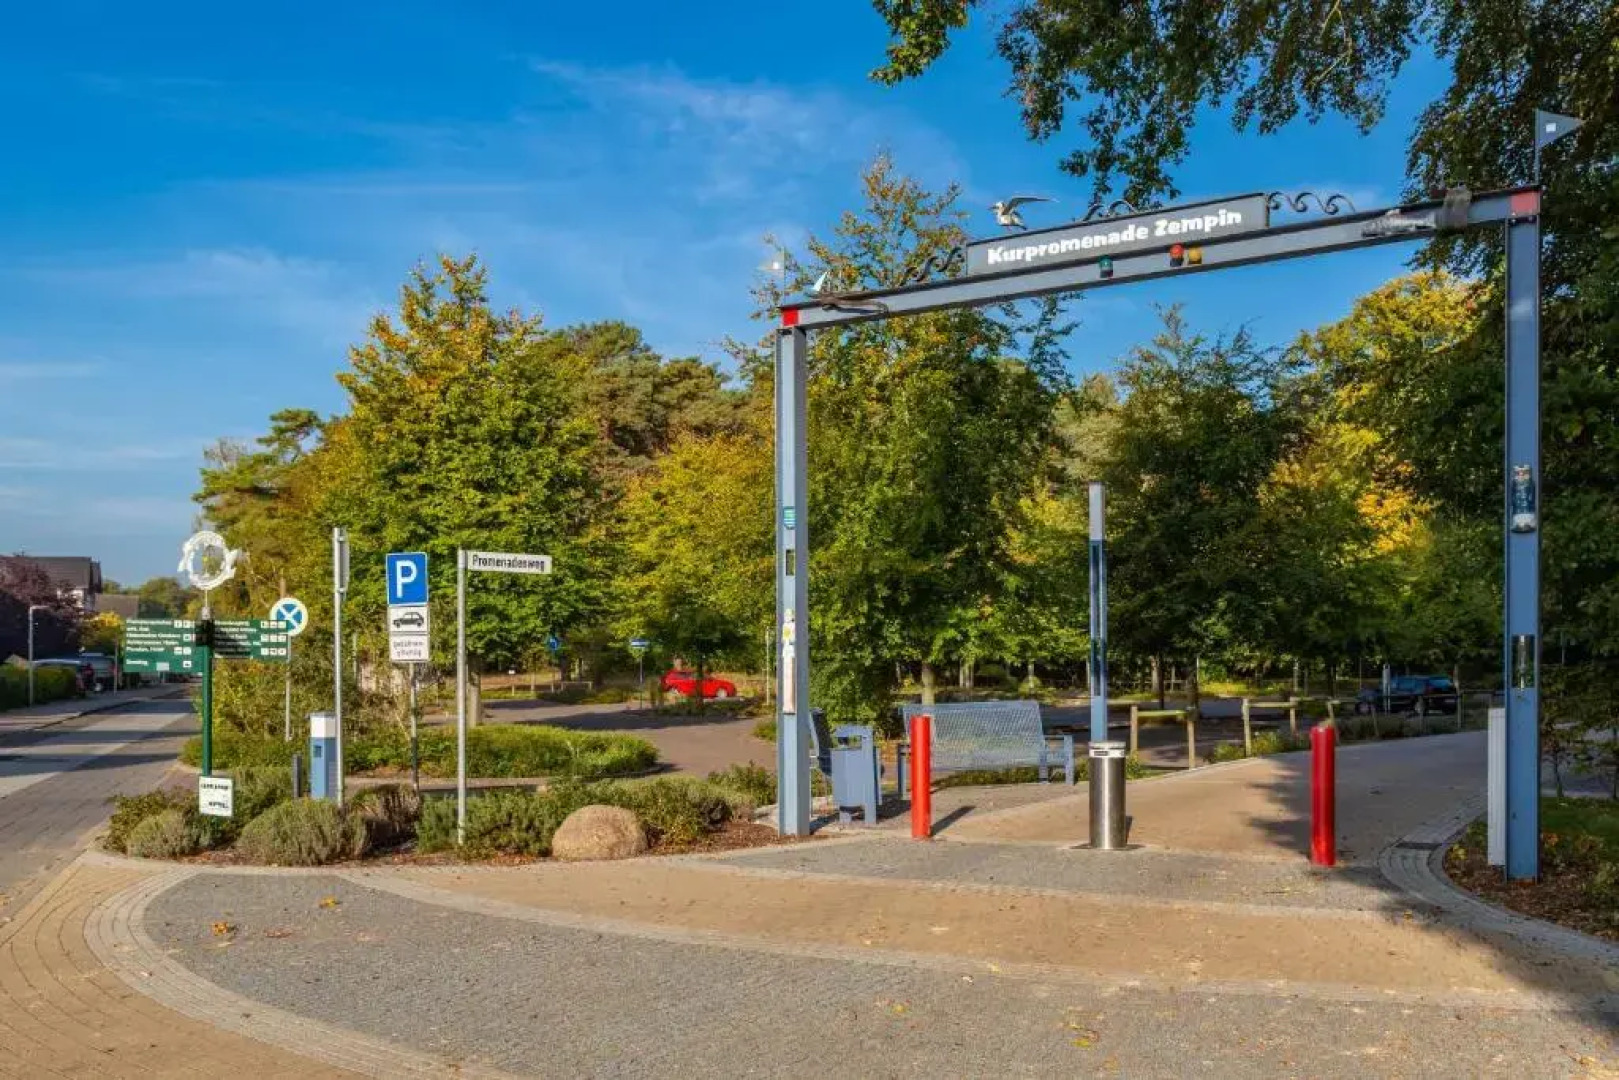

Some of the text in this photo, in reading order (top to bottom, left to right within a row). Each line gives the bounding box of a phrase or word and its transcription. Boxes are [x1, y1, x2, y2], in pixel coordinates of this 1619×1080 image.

[987, 209, 1241, 265] Kurpromenade Zempin
[396, 559, 417, 598] P
